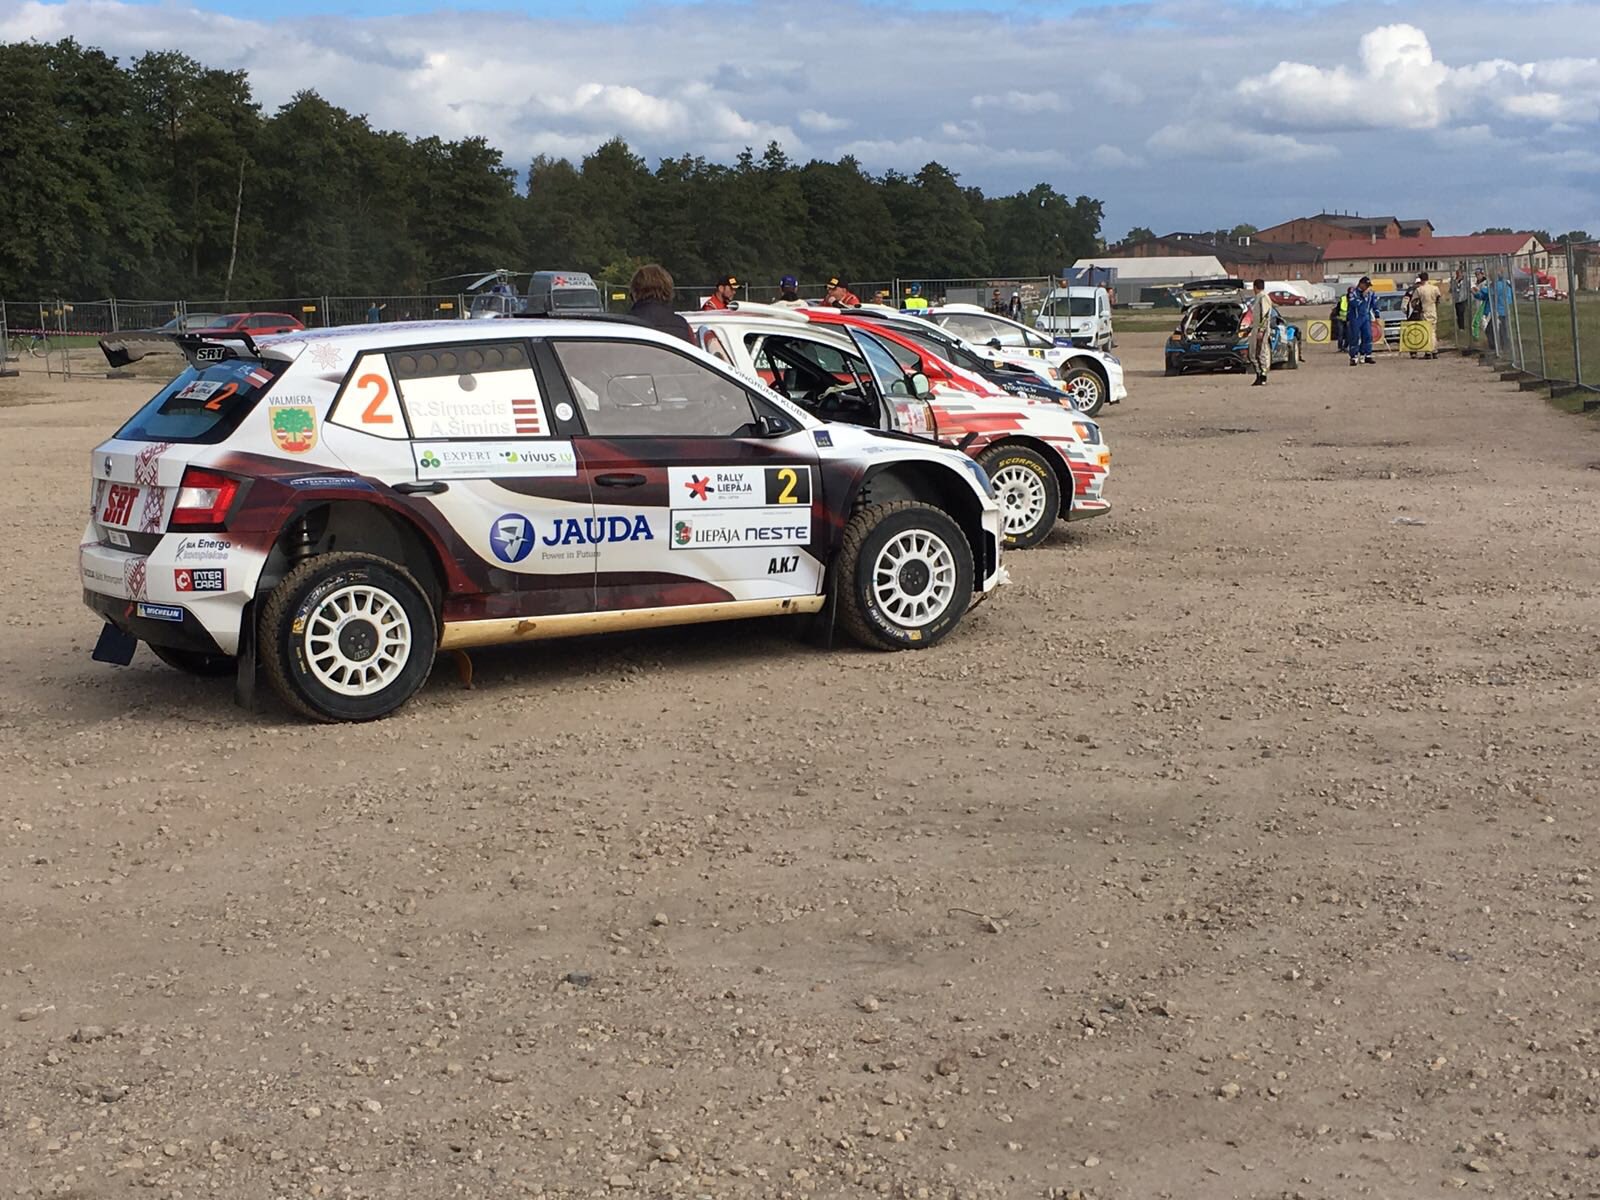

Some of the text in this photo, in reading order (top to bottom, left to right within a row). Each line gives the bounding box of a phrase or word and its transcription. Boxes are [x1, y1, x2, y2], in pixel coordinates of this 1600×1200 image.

[197, 348, 225, 360] SRT
[205, 383, 239, 410] 2
[269, 396, 314, 405] VALMIERA
[356, 373, 394, 424] 2
[443, 451, 492, 461] EXPERT
[520, 451, 557, 463] vivus
[998, 457, 1047, 478] SCORPION
[717, 473, 744, 482] RALLY
[777, 468, 799, 504] 2
[102, 484, 140, 527] SRT
[542, 515, 654, 546] JAUDA
[695, 526, 808, 543] LIEPĀJA NESTE
[198, 539, 232, 551] Energo
[542, 551, 565, 560] Power
[567, 550, 575, 559] in
[767, 556, 800, 574] A.K.7
[193, 571, 222, 580] INTER
[194, 580, 222, 589] CARS
[146, 607, 180, 617] MICHELIN
